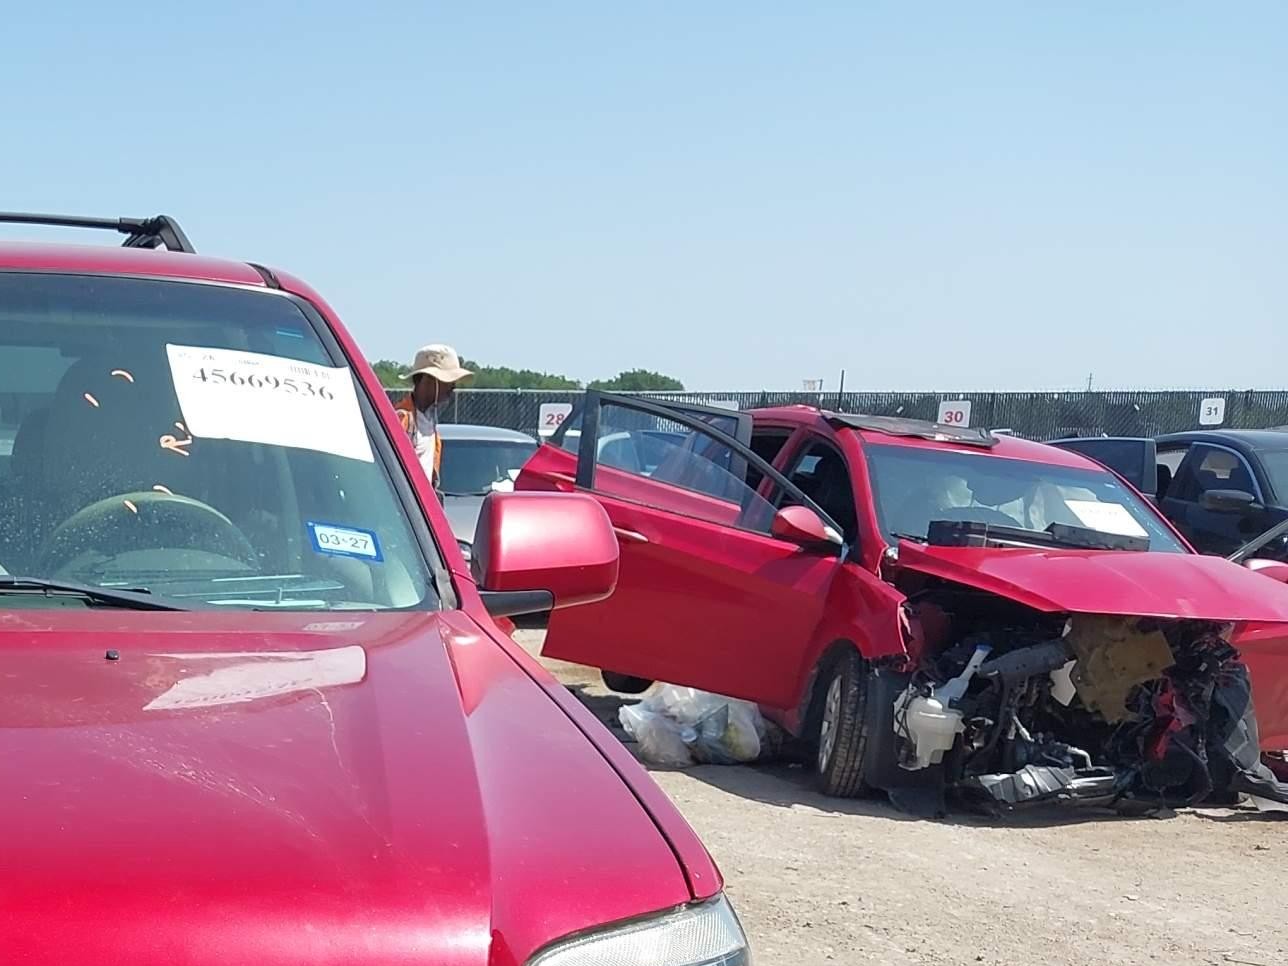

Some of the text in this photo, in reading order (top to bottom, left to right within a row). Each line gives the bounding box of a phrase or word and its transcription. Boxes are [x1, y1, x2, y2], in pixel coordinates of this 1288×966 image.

[192, 367, 334, 401] 45669536
[944, 411, 964, 423] 30
[1205, 406, 1218, 416] 31
